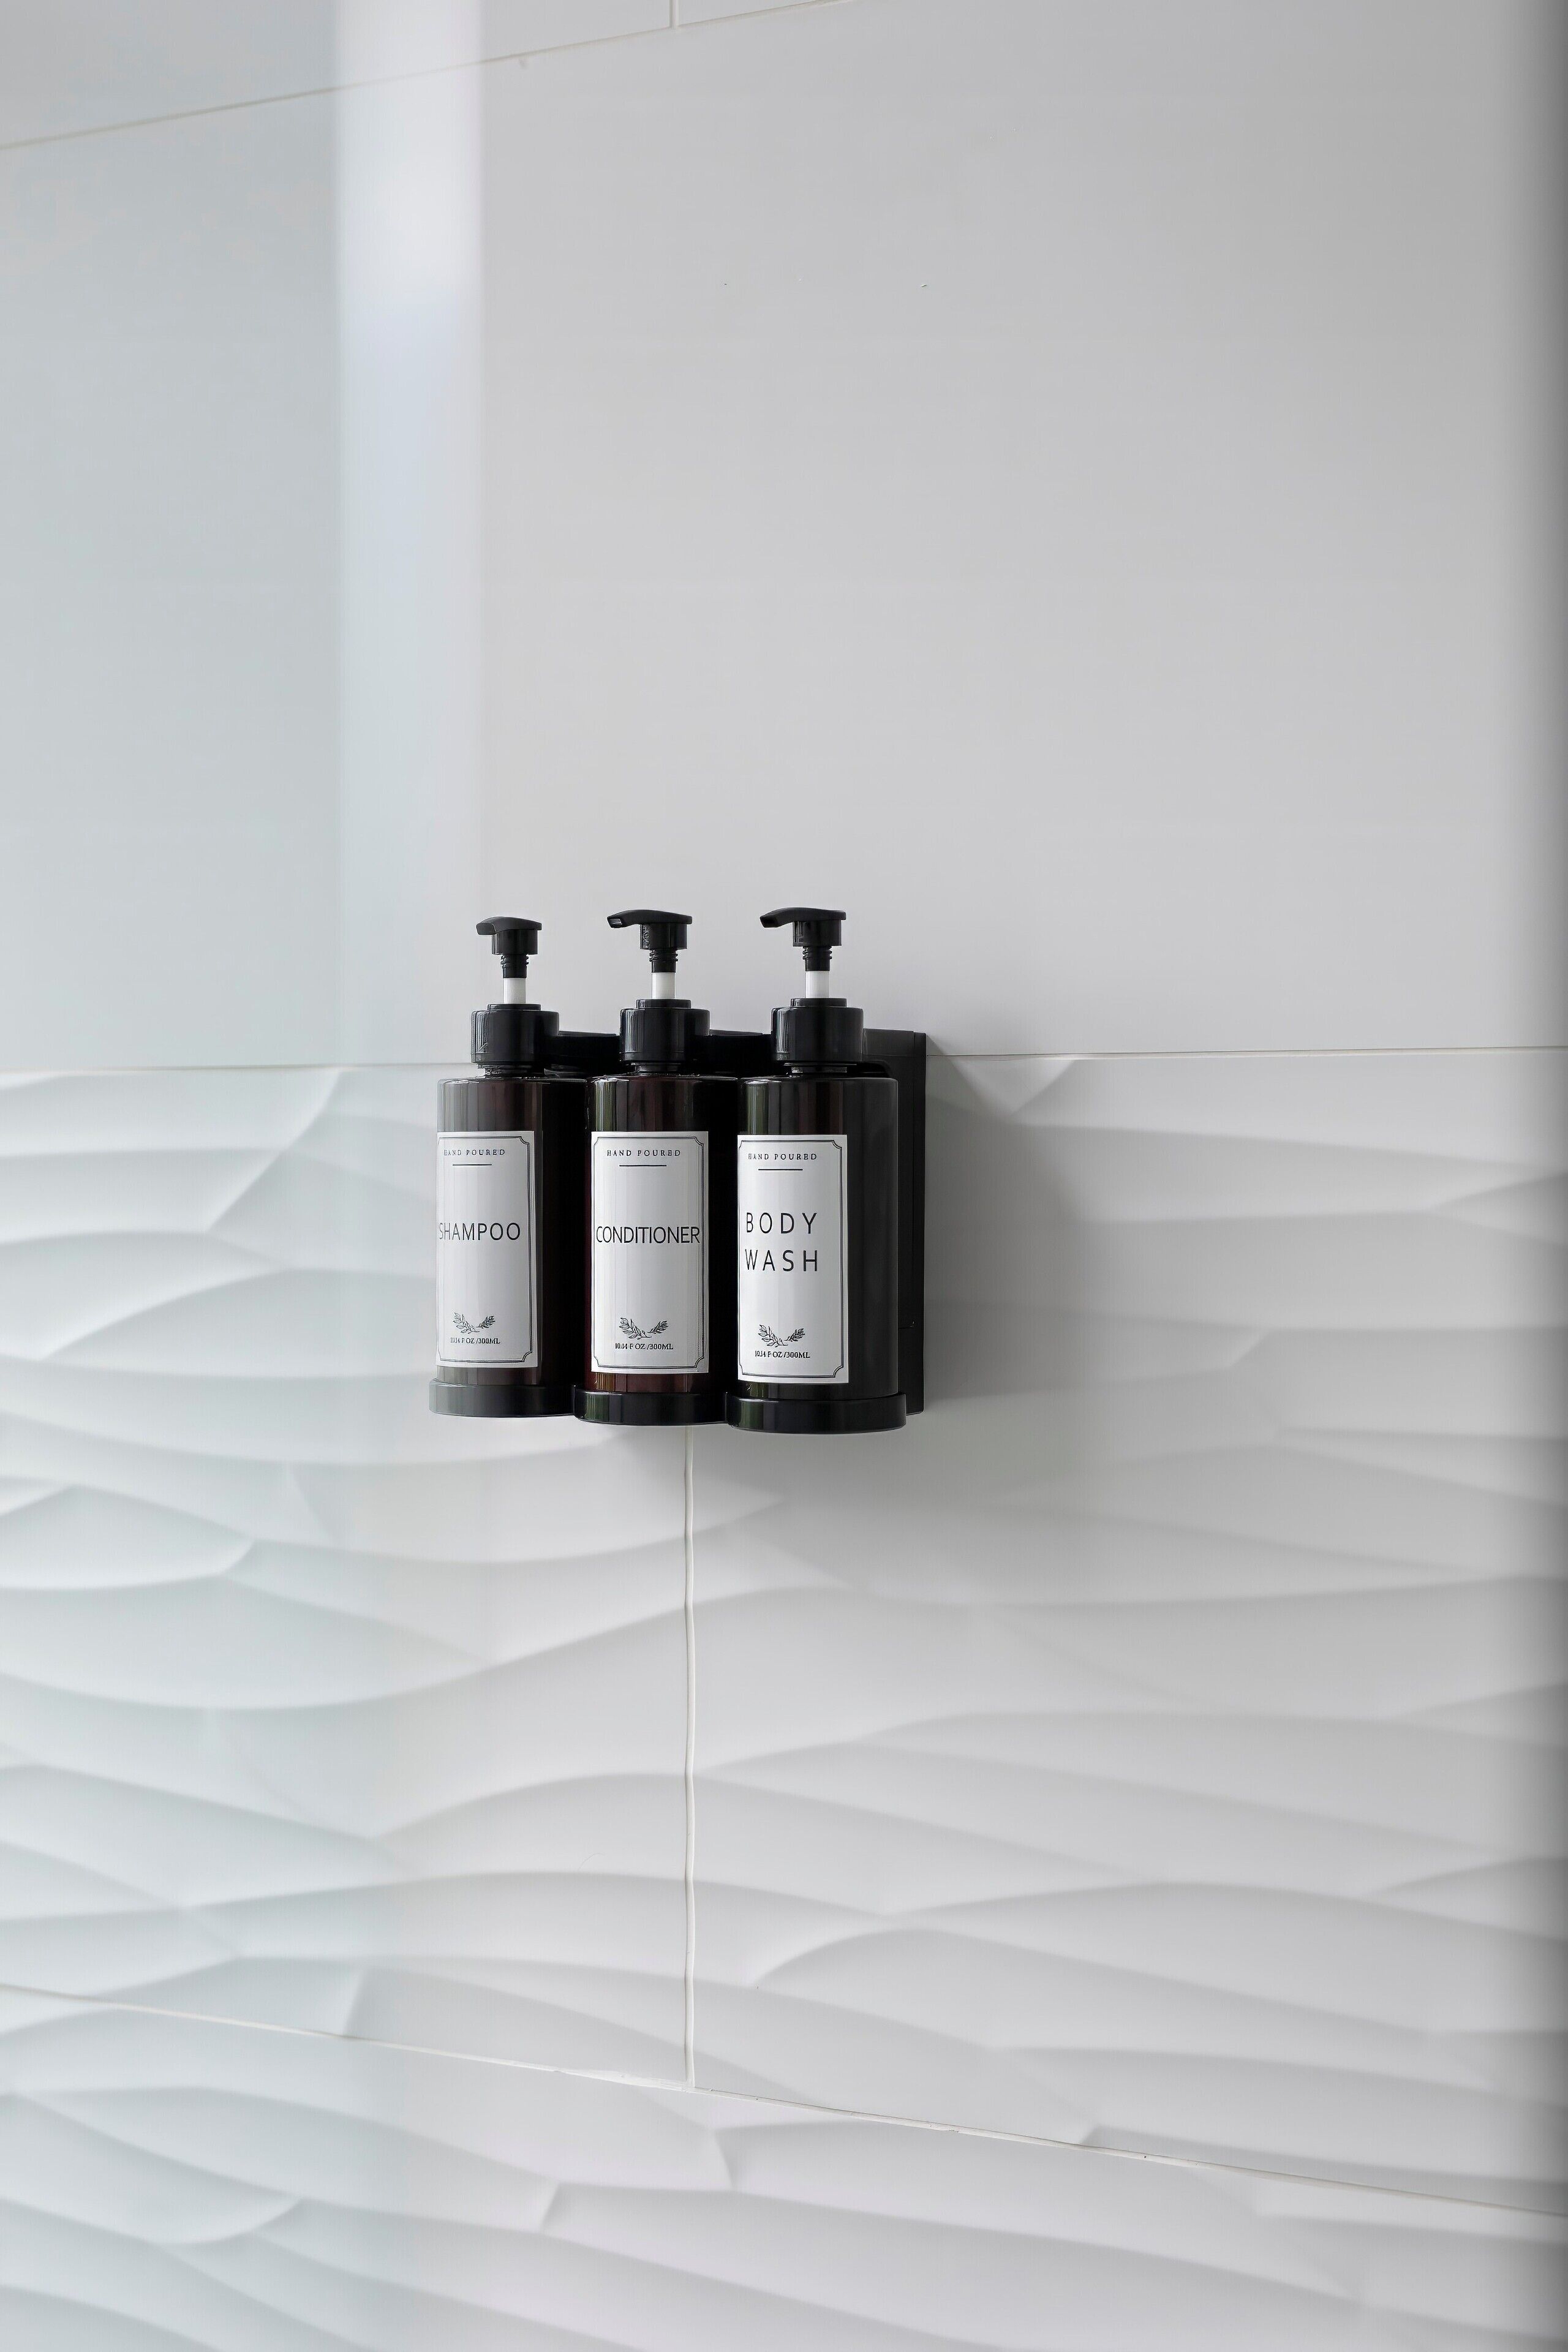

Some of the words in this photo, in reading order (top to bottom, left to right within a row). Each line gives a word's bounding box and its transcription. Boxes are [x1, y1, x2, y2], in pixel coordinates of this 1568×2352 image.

[439, 1222, 521, 1241] SHAMPOO
[746, 1212, 817, 1234] BODY
[596, 1226, 701, 1244] CONDITIONER
[745, 1248, 818, 1272] WASH
